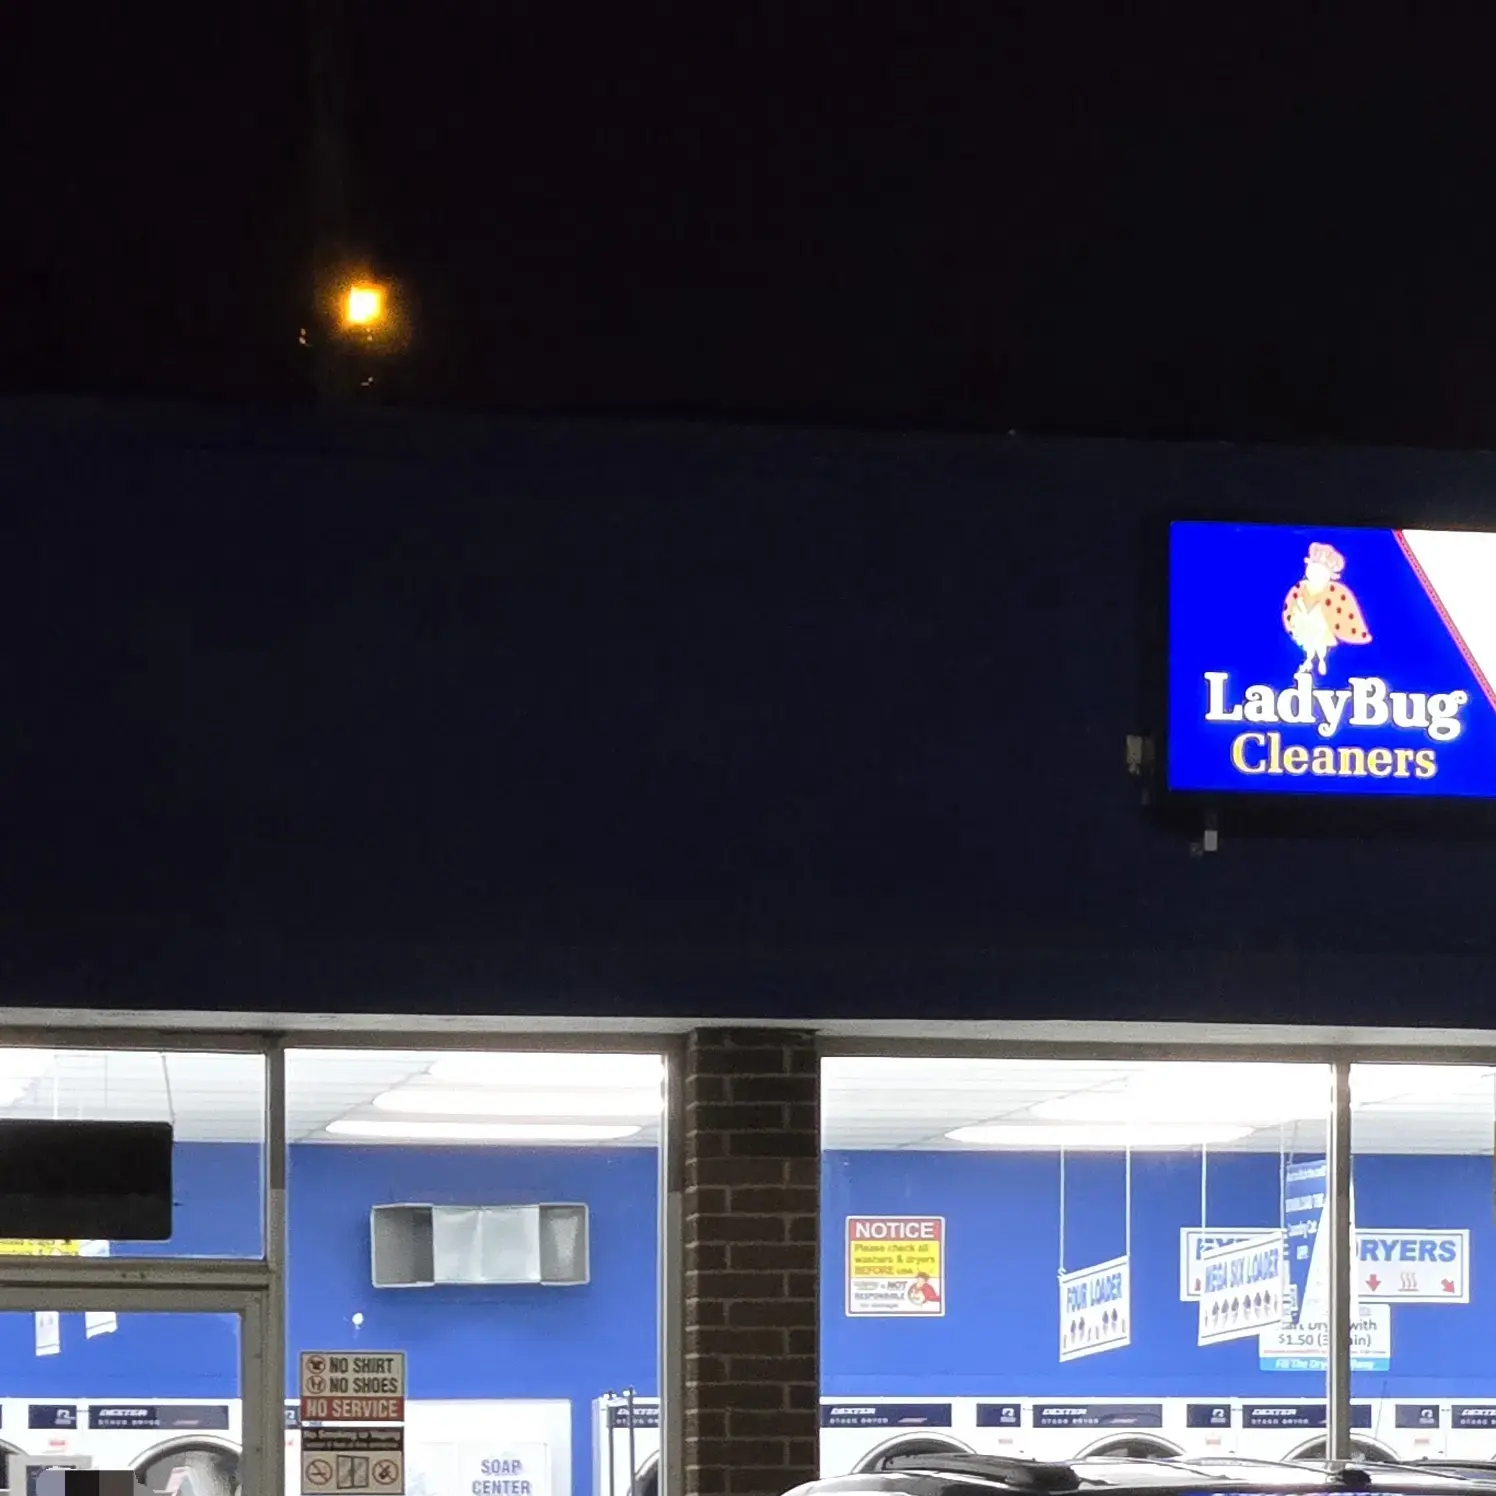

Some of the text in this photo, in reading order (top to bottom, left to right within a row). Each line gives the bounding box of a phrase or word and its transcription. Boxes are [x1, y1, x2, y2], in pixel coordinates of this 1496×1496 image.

[1203, 671, 1469, 742] LadyBug
[1230, 731, 1438, 779] Cleaners
[855, 1222, 935, 1239] NOTICE
[1356, 1240, 1457, 1262] RYERS
[329, 1357, 394, 1374] NO SHIRT
[329, 1377, 398, 1393] NO SHOES
[306, 1399, 398, 1418] NO SERVICE
[480, 1459, 522, 1476] SOAP
[471, 1479, 532, 1496] CENTER
